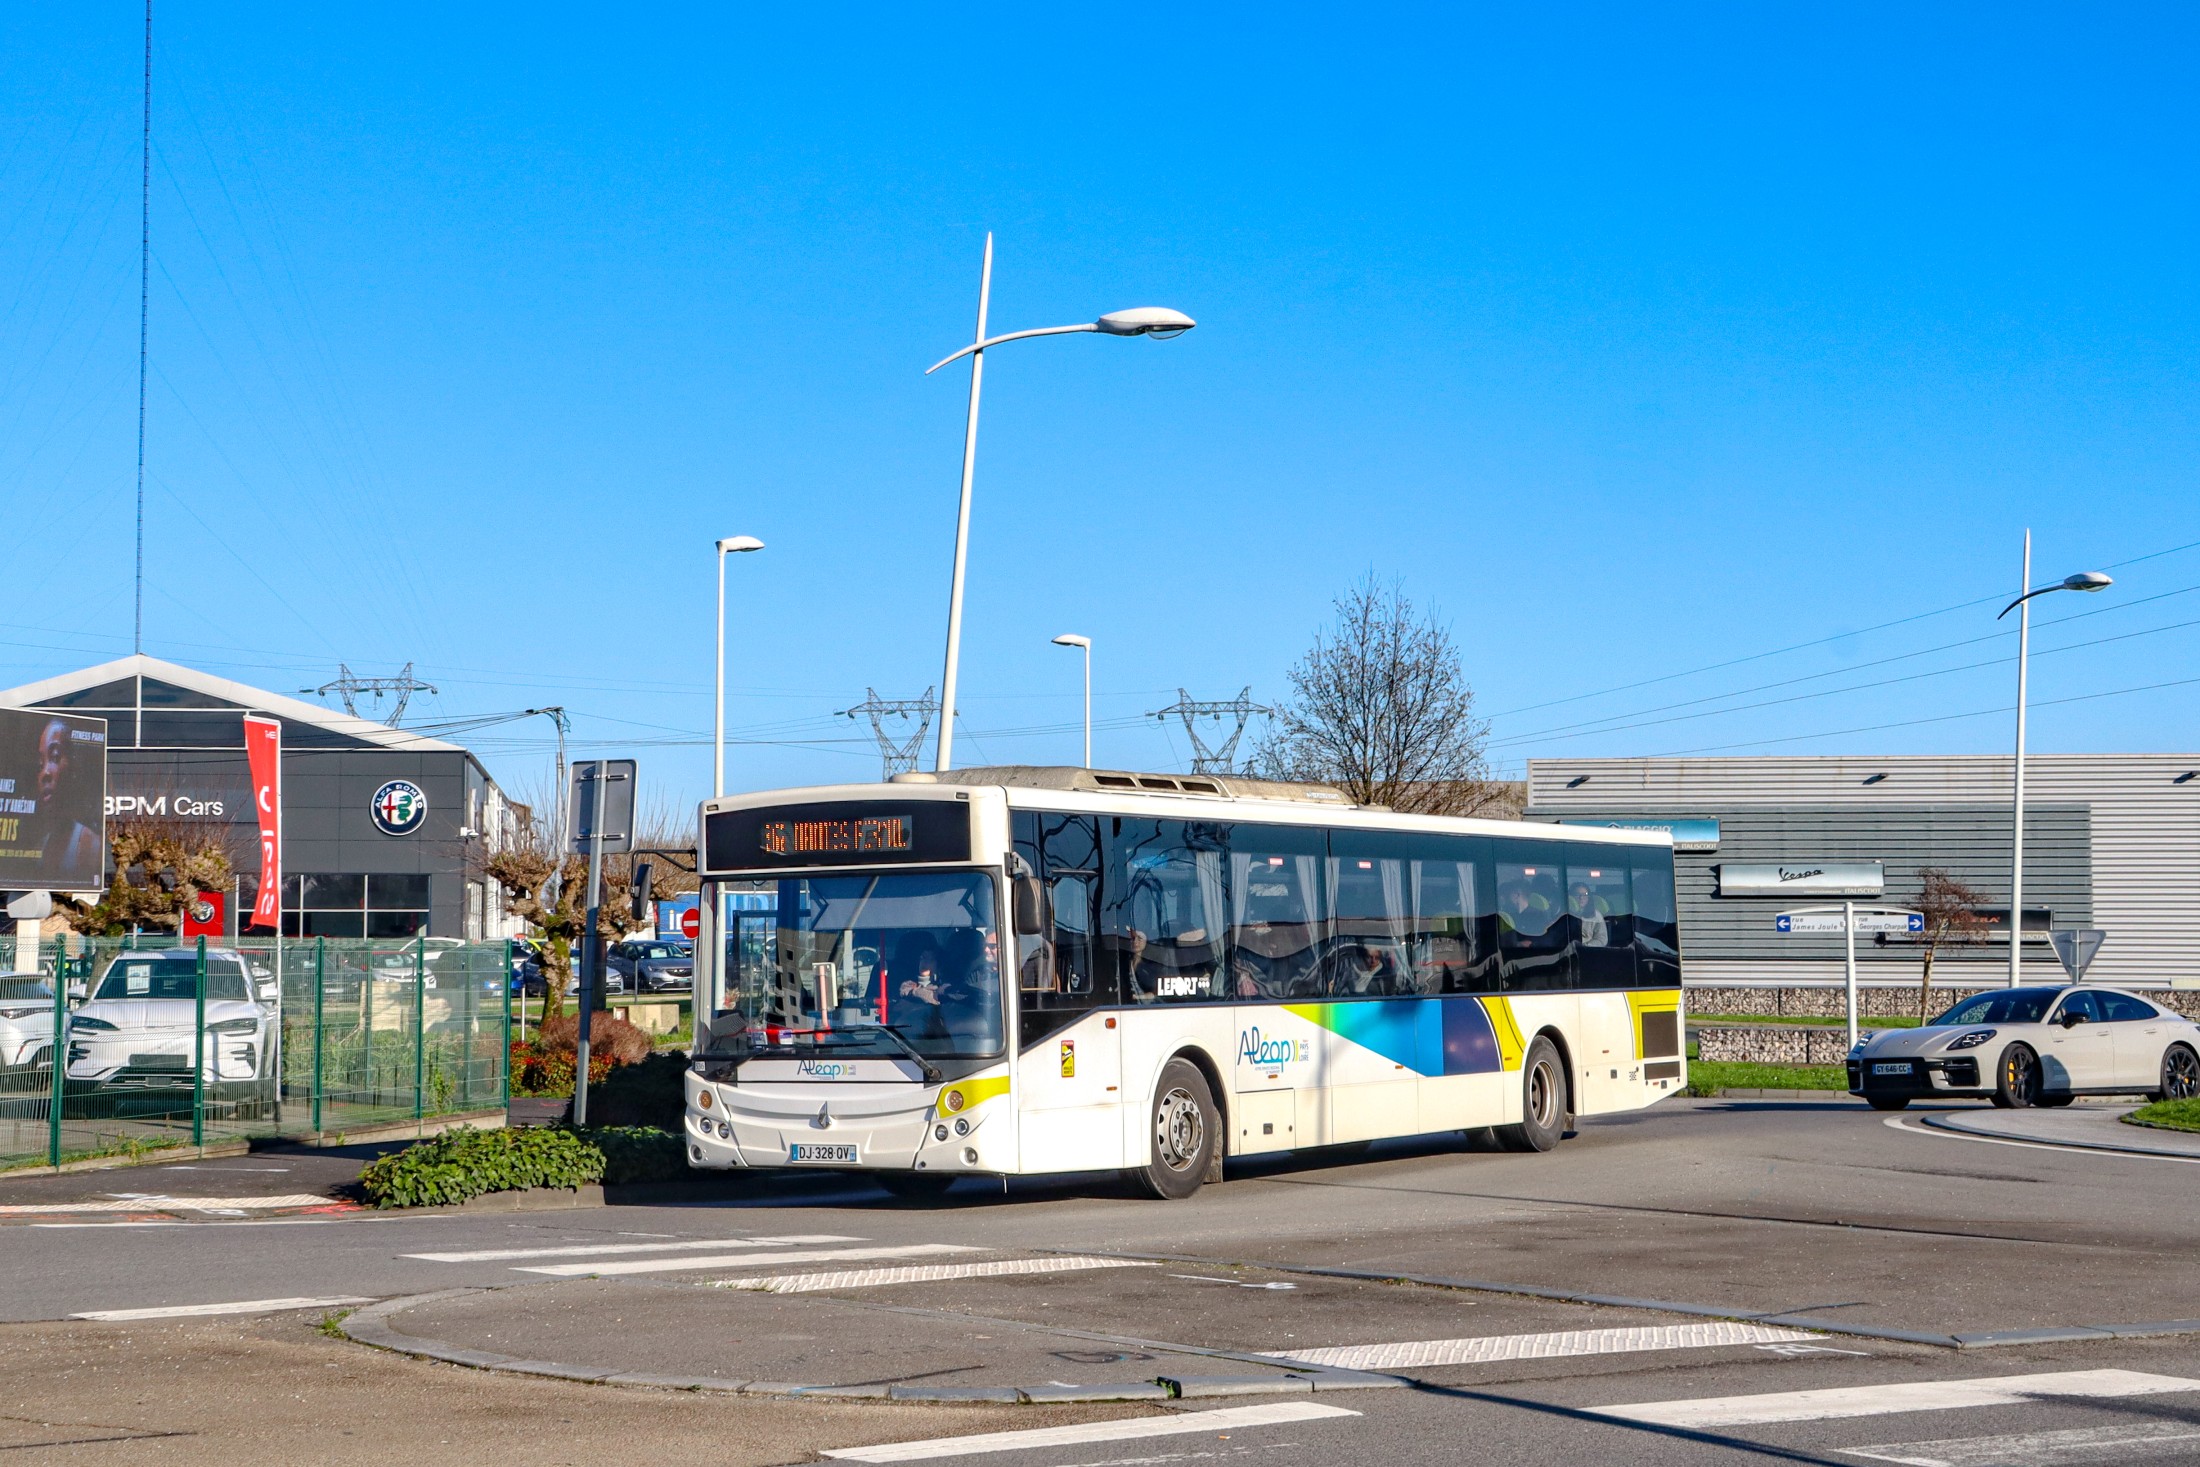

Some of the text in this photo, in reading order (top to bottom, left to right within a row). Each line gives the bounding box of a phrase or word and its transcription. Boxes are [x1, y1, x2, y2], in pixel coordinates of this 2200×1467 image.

[71, 729, 104, 743] FITNESS PARK
[174, 796, 224, 816] Cars
[375, 787, 393, 809] ALFA
[1778, 867, 1825, 882] Vespa
[1859, 923, 1883, 931] Georges
[1157, 976, 1198, 996] LEFORT
